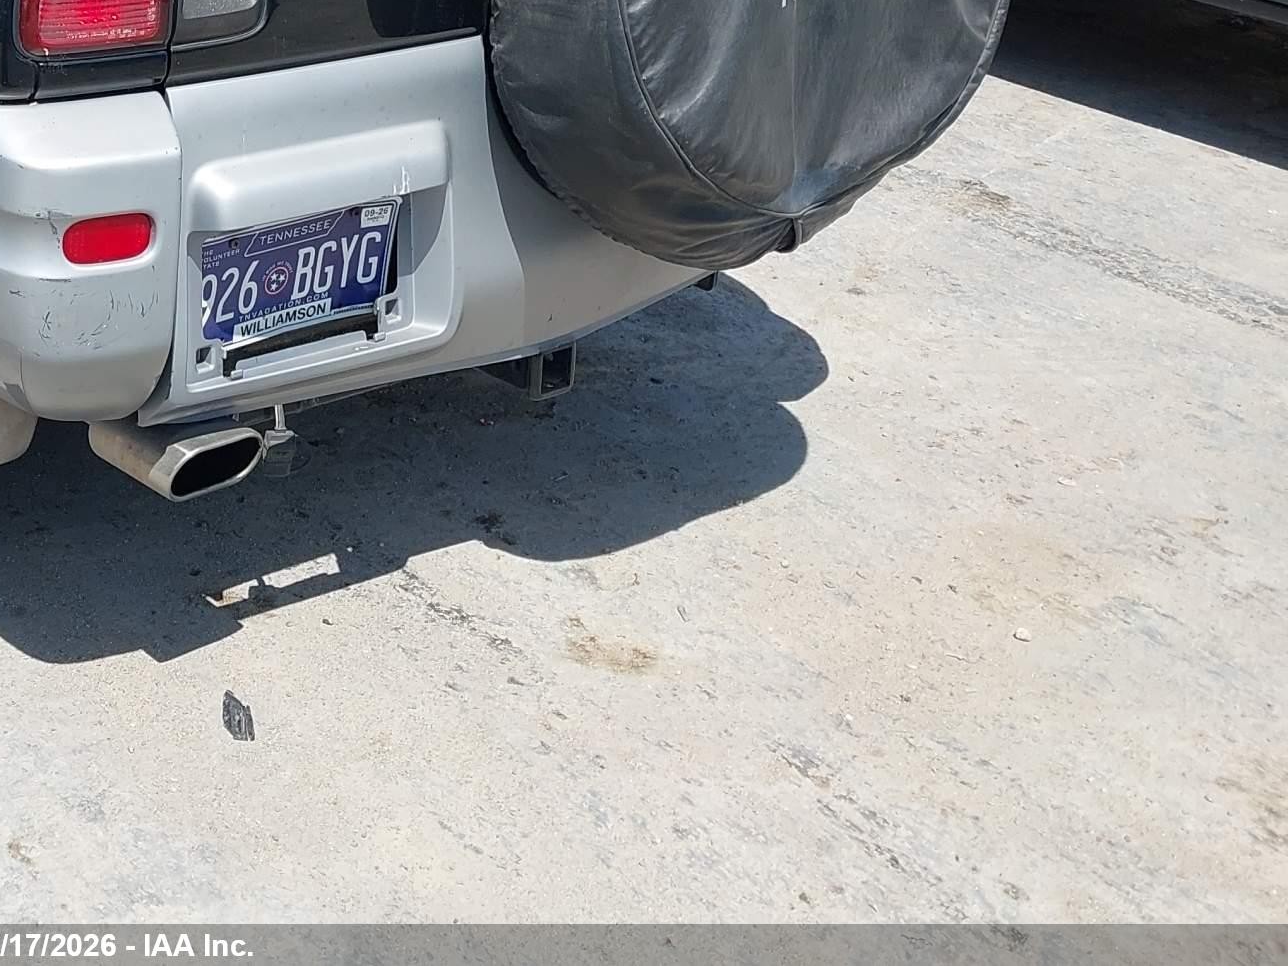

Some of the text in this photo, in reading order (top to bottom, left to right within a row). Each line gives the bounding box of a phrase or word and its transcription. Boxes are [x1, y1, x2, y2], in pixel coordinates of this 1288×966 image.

[259, 218, 333, 246] TENNESSEE
[202, 248, 241, 264] OLUNTEER
[202, 231, 382, 329] 926 BGYG
[240, 302, 328, 338] WILLIAMSON
